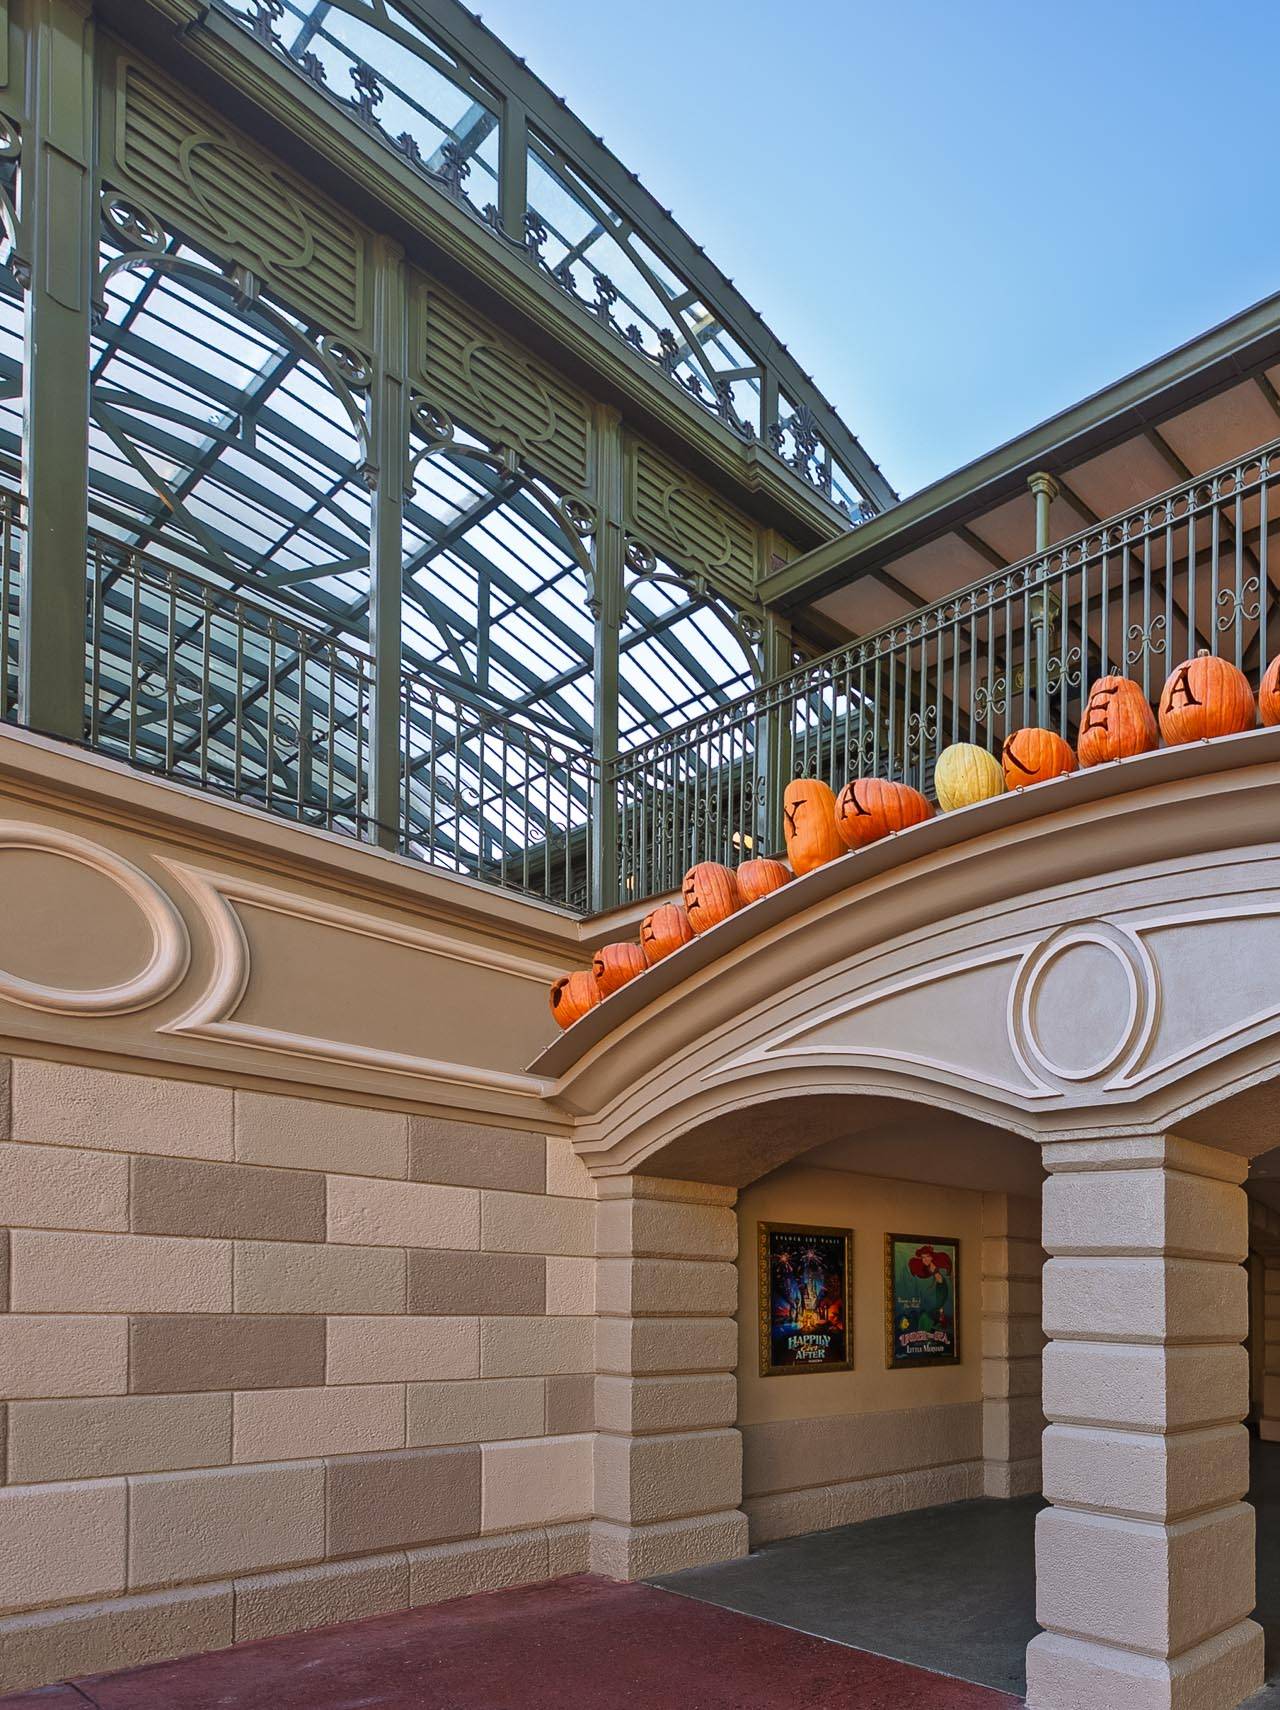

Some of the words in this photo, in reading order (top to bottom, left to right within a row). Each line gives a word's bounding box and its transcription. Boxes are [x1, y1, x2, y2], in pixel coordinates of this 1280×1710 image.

[784, 782, 872, 838] YA
[788, 1334, 831, 1350] HAPPILY
[795, 1349, 826, 1360] AFTER
